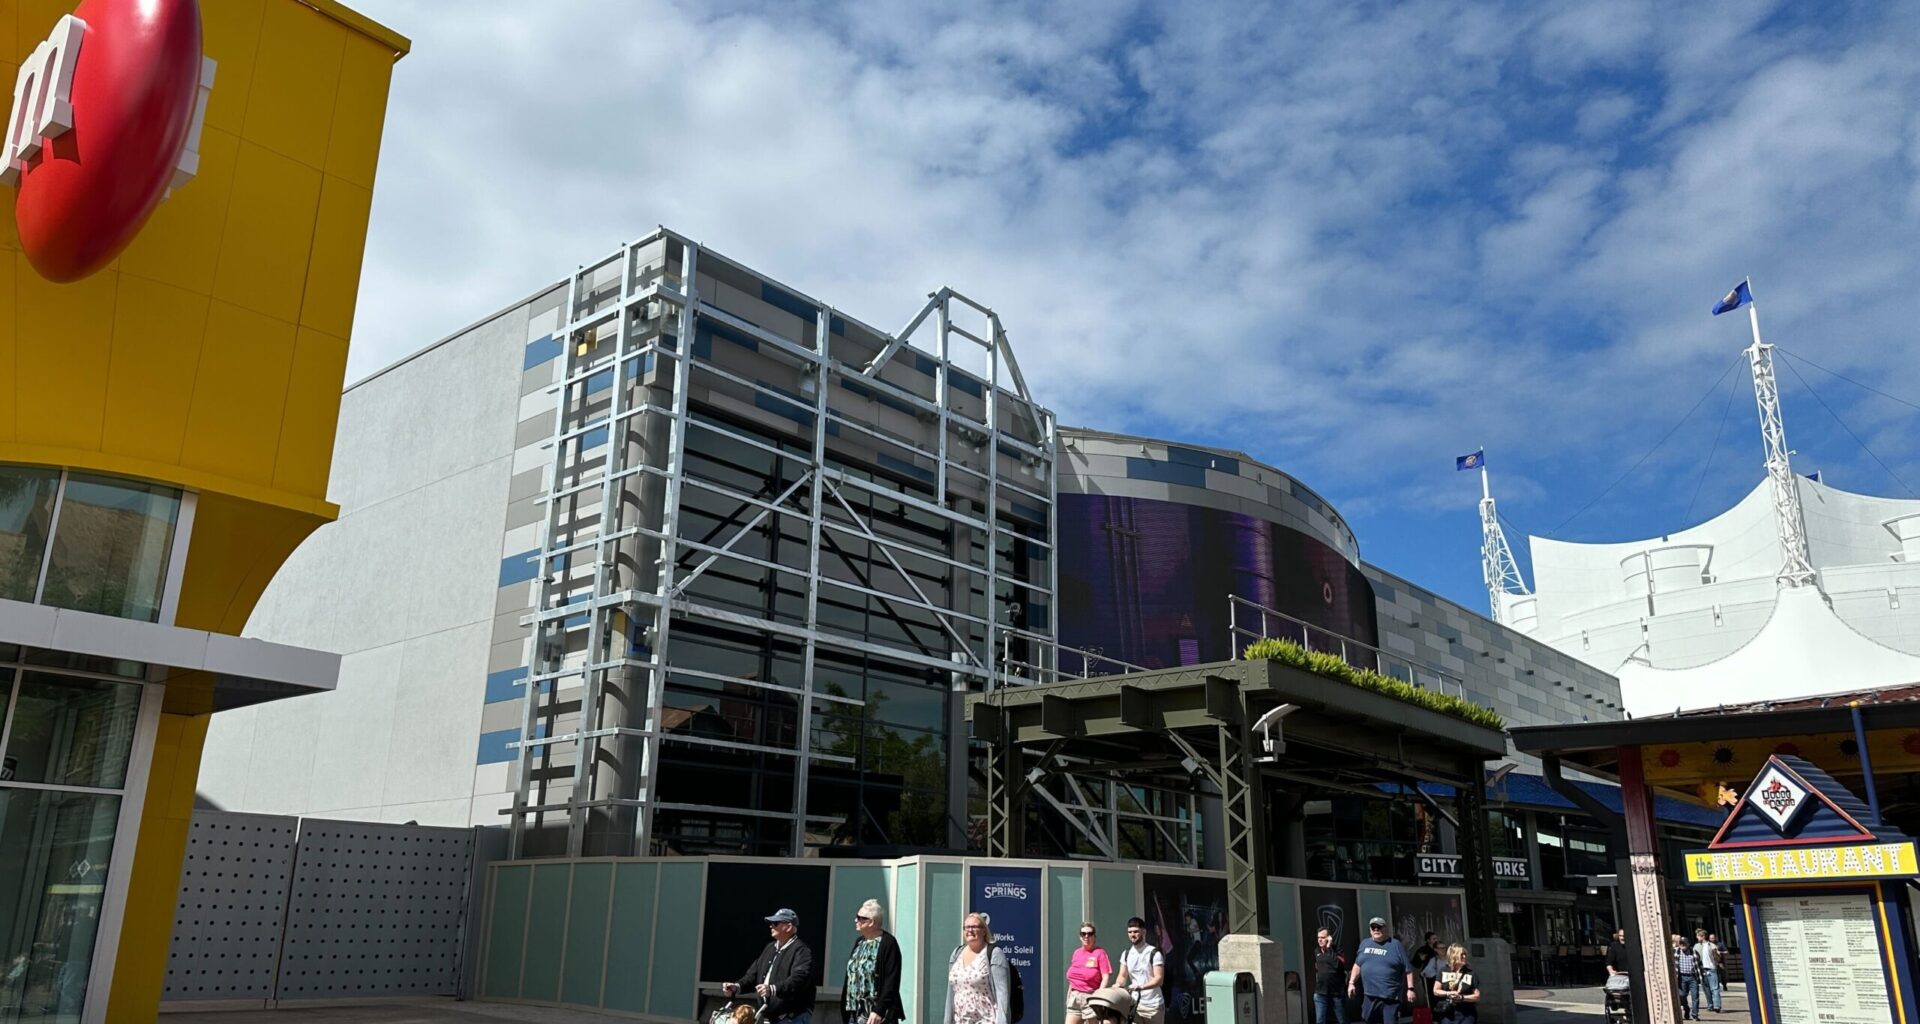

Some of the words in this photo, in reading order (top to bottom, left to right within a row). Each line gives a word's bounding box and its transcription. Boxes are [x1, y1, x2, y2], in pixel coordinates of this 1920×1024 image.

[1421, 858, 1457, 873] CITY
[1492, 861, 1526, 876] ORKS
[1696, 857, 1713, 876] the
[1711, 844, 1902, 879] RESTAURANT
[984, 886, 1027, 900] SPRINGS
[993, 933, 1015, 941] Works
[1002, 946, 1012, 954] du
[1014, 945, 1034, 954] Soleil
[1011, 958, 1031, 967] Blues
